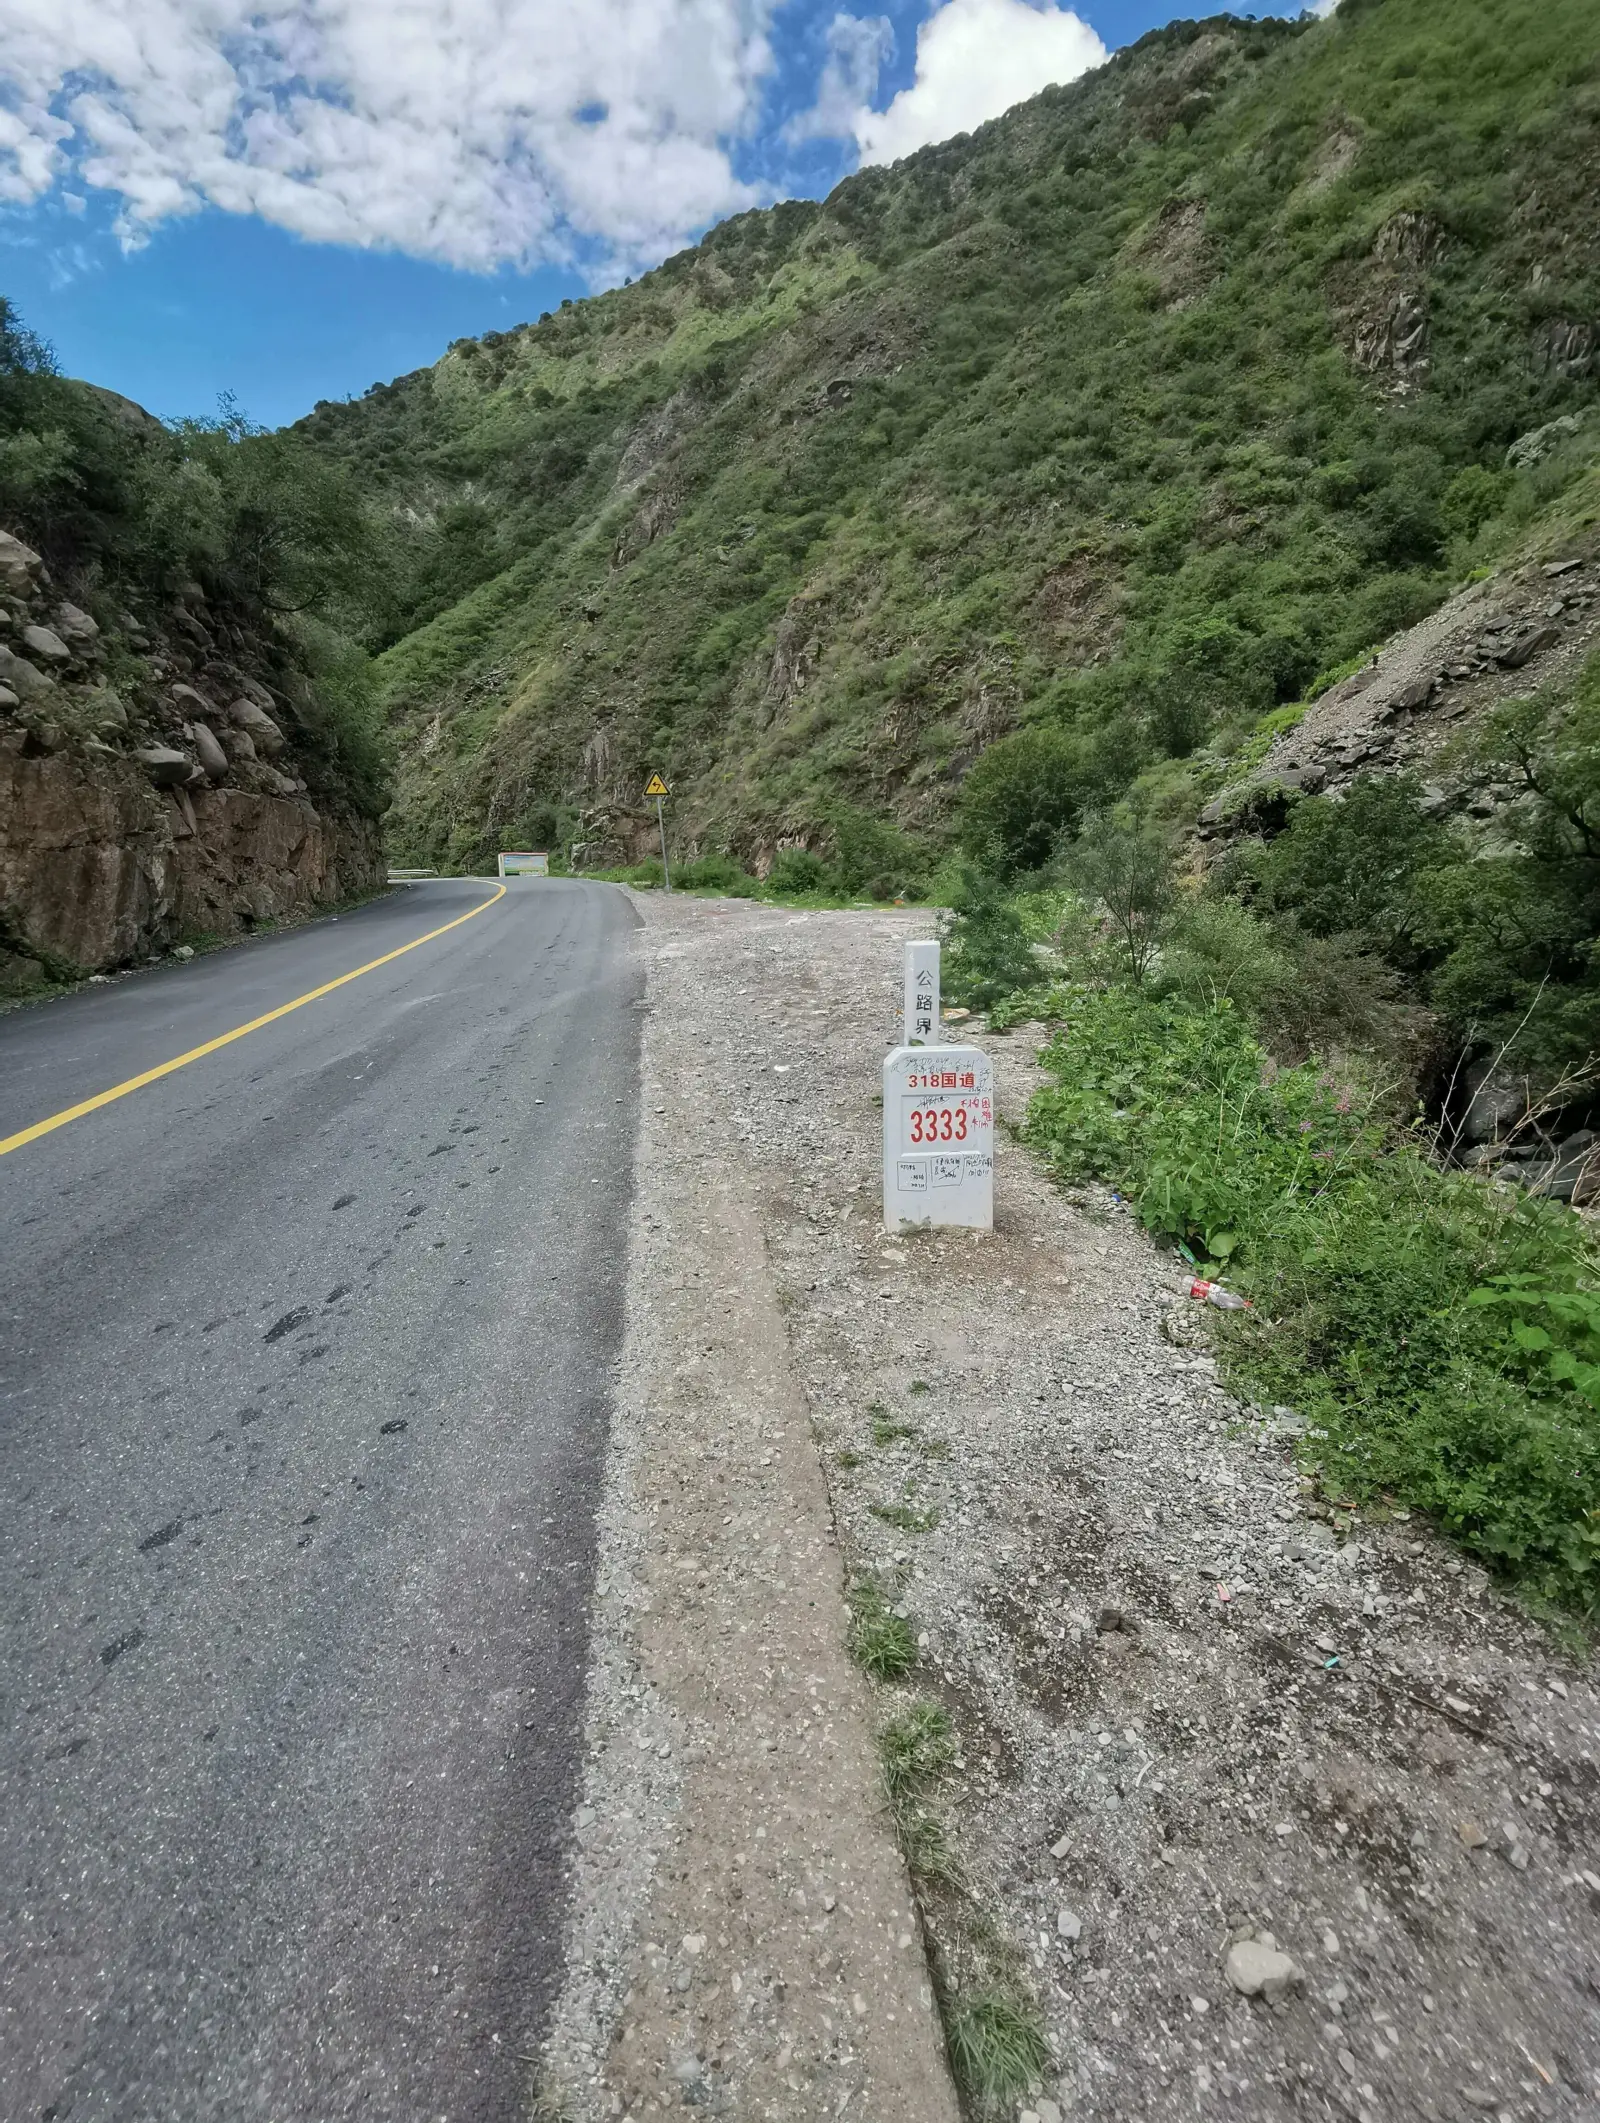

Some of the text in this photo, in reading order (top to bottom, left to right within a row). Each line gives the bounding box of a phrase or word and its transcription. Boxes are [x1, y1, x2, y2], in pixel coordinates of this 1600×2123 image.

[915, 970, 934, 1035] 公路界
[908, 1072, 975, 1089] 318国道
[910, 1108, 967, 1143] 3333
